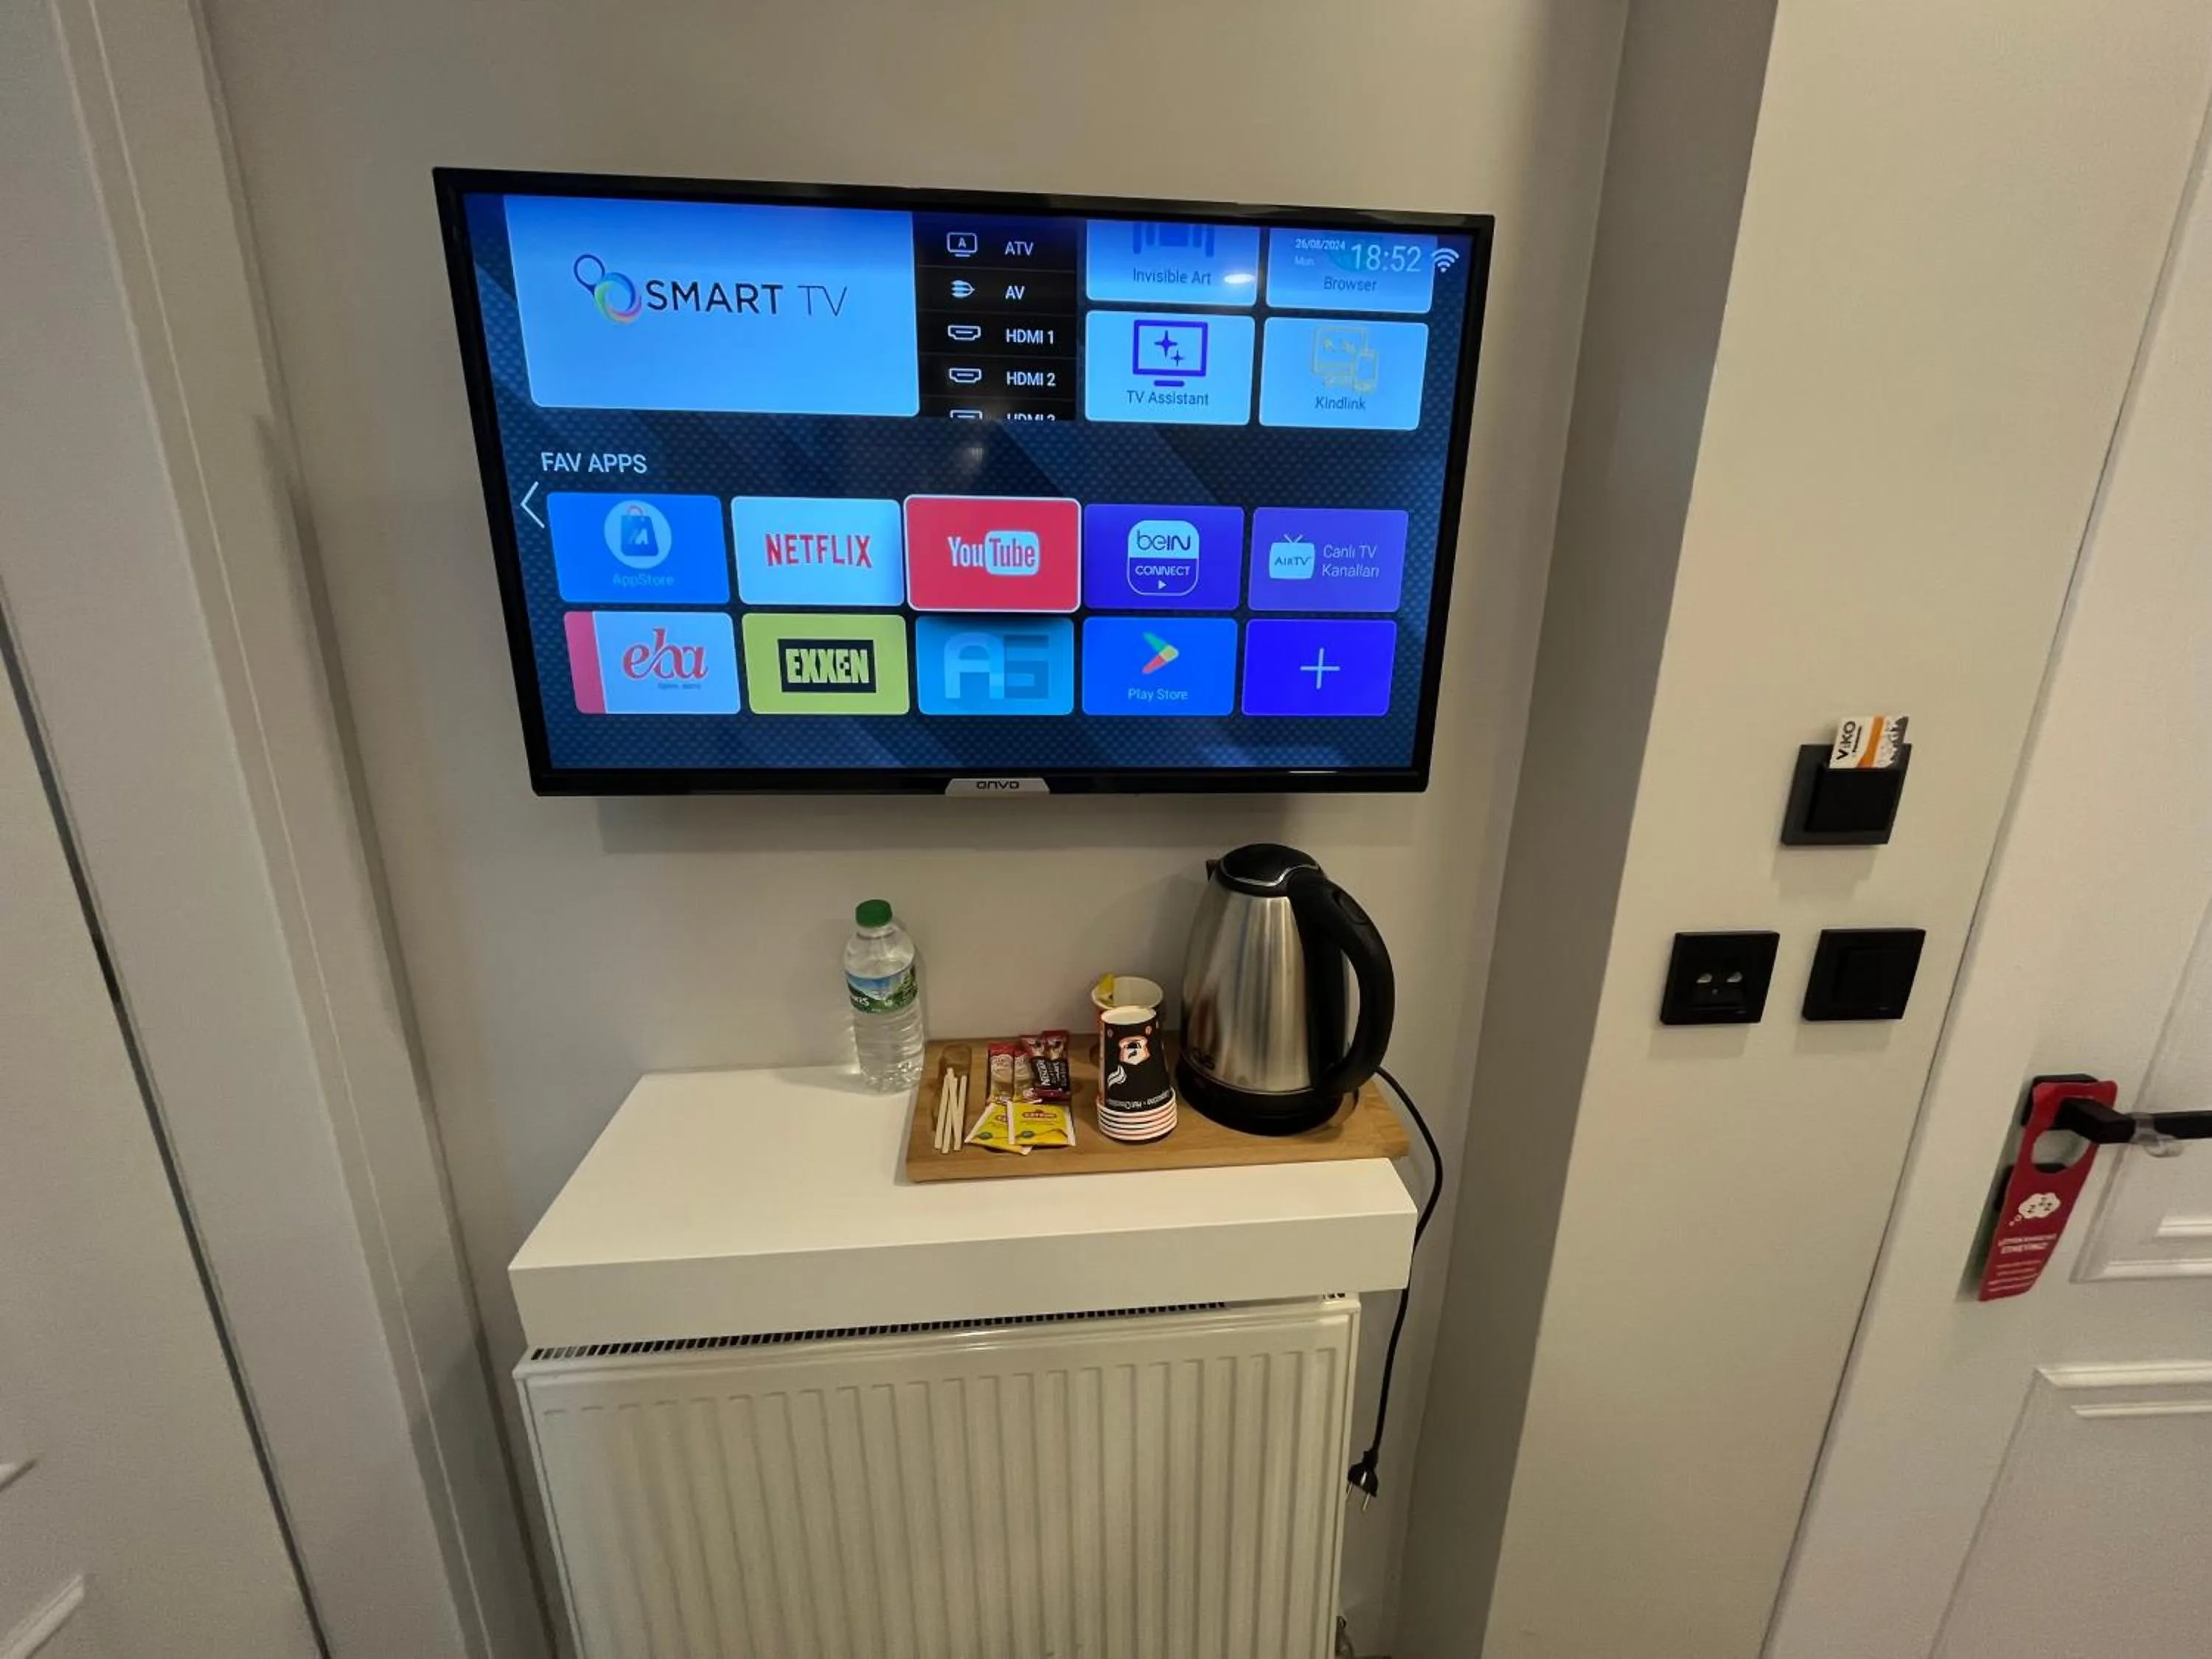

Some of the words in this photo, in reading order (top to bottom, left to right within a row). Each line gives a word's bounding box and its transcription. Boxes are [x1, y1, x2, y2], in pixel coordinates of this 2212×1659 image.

[1005, 241, 1034, 256] ATV
[1295, 238, 1346, 251] 26/08/2024
[1352, 243, 1422, 272] 18:52
[1133, 267, 1188, 284] Invisible
[1191, 271, 1211, 285] Art
[1324, 276, 1377, 292] Browser
[645, 279, 783, 315] SMART
[797, 285, 848, 317] TV
[1005, 285, 1026, 300] AV
[1006, 329, 1044, 344] HDMI
[1048, 330, 1054, 344] 1
[1006, 371, 1044, 386] HDMI
[1047, 373, 1056, 387] 2
[1127, 390, 1144, 405] TV
[1147, 390, 1209, 406] Assistant
[1315, 396, 1366, 411] Kindlink
[540, 452, 582, 472] FAV
[588, 453, 647, 474] APPS
[765, 533, 873, 568] NETFLIX
[947, 536, 1036, 567] YouTube
[1359, 545, 1378, 558] TV
[1135, 566, 1191, 576] CONNECT
[613, 573, 674, 588] AppStore
[623, 627, 708, 679] eba
[785, 649, 869, 684] EXXEN
[1128, 688, 1154, 703] Play
[1157, 688, 1189, 700] Store
[1836, 720, 1856, 760] VIKO
